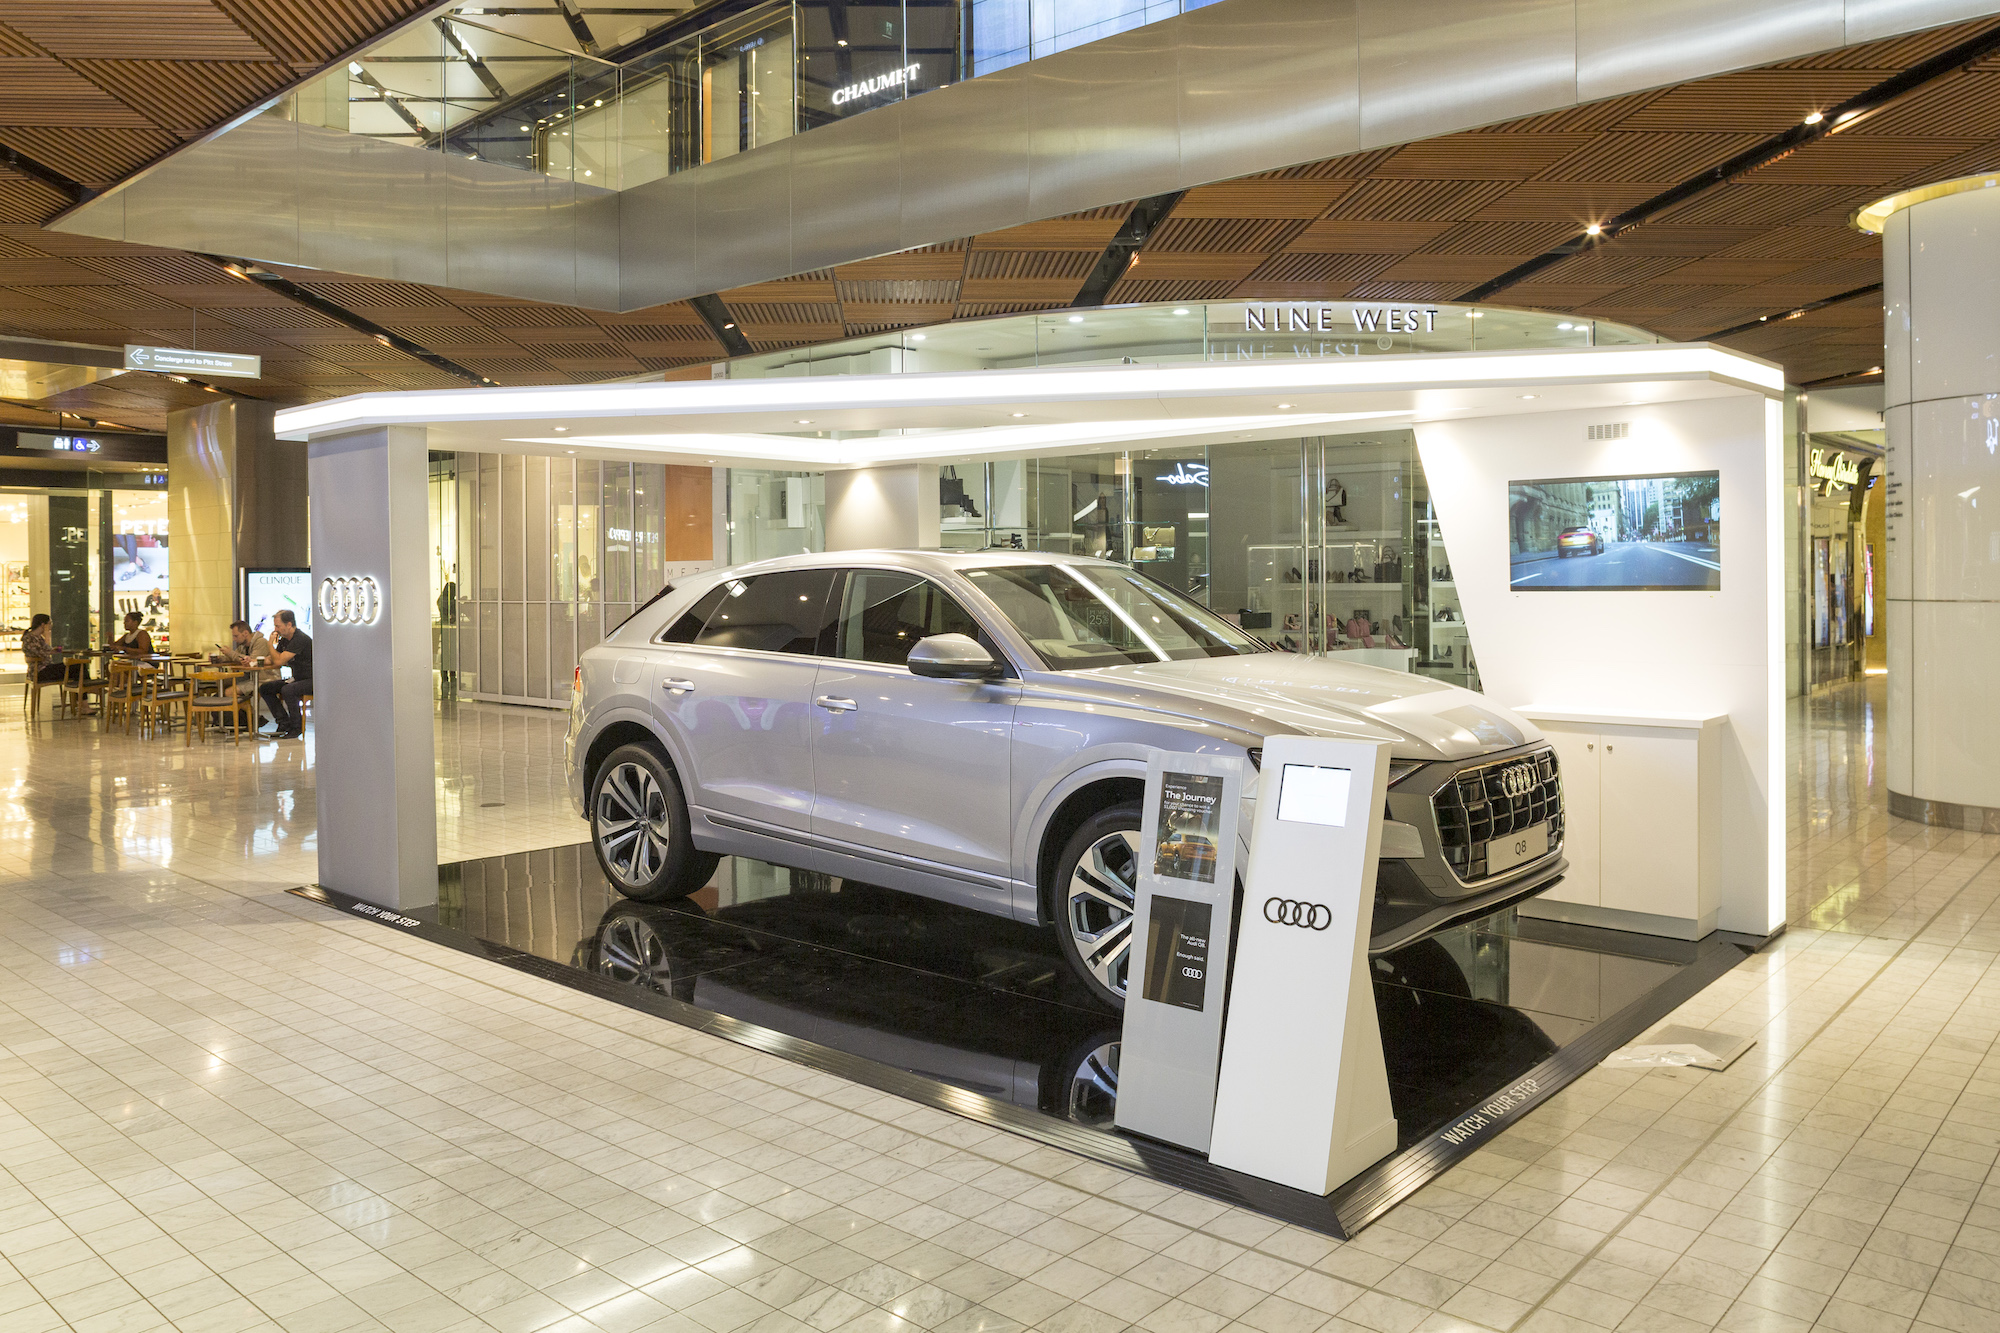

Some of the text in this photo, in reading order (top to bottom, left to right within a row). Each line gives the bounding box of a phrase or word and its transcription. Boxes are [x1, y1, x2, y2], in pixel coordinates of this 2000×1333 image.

[832, 63, 920, 105] CHAUMET
[1245, 307, 1438, 333] NINE WEST
[154, 354, 183, 364] Concierge
[214, 359, 233, 367] Street
[260, 576, 302, 585] CLINIQUE
[1165, 790, 1216, 805] The Journey
[1515, 840, 1527, 856] Q8
[351, 902, 421, 928] WATCH YOUR STEP
[1176, 951, 1193, 960] Enough
[1440, 1078, 1540, 1145] WATCH YOUR STEP
